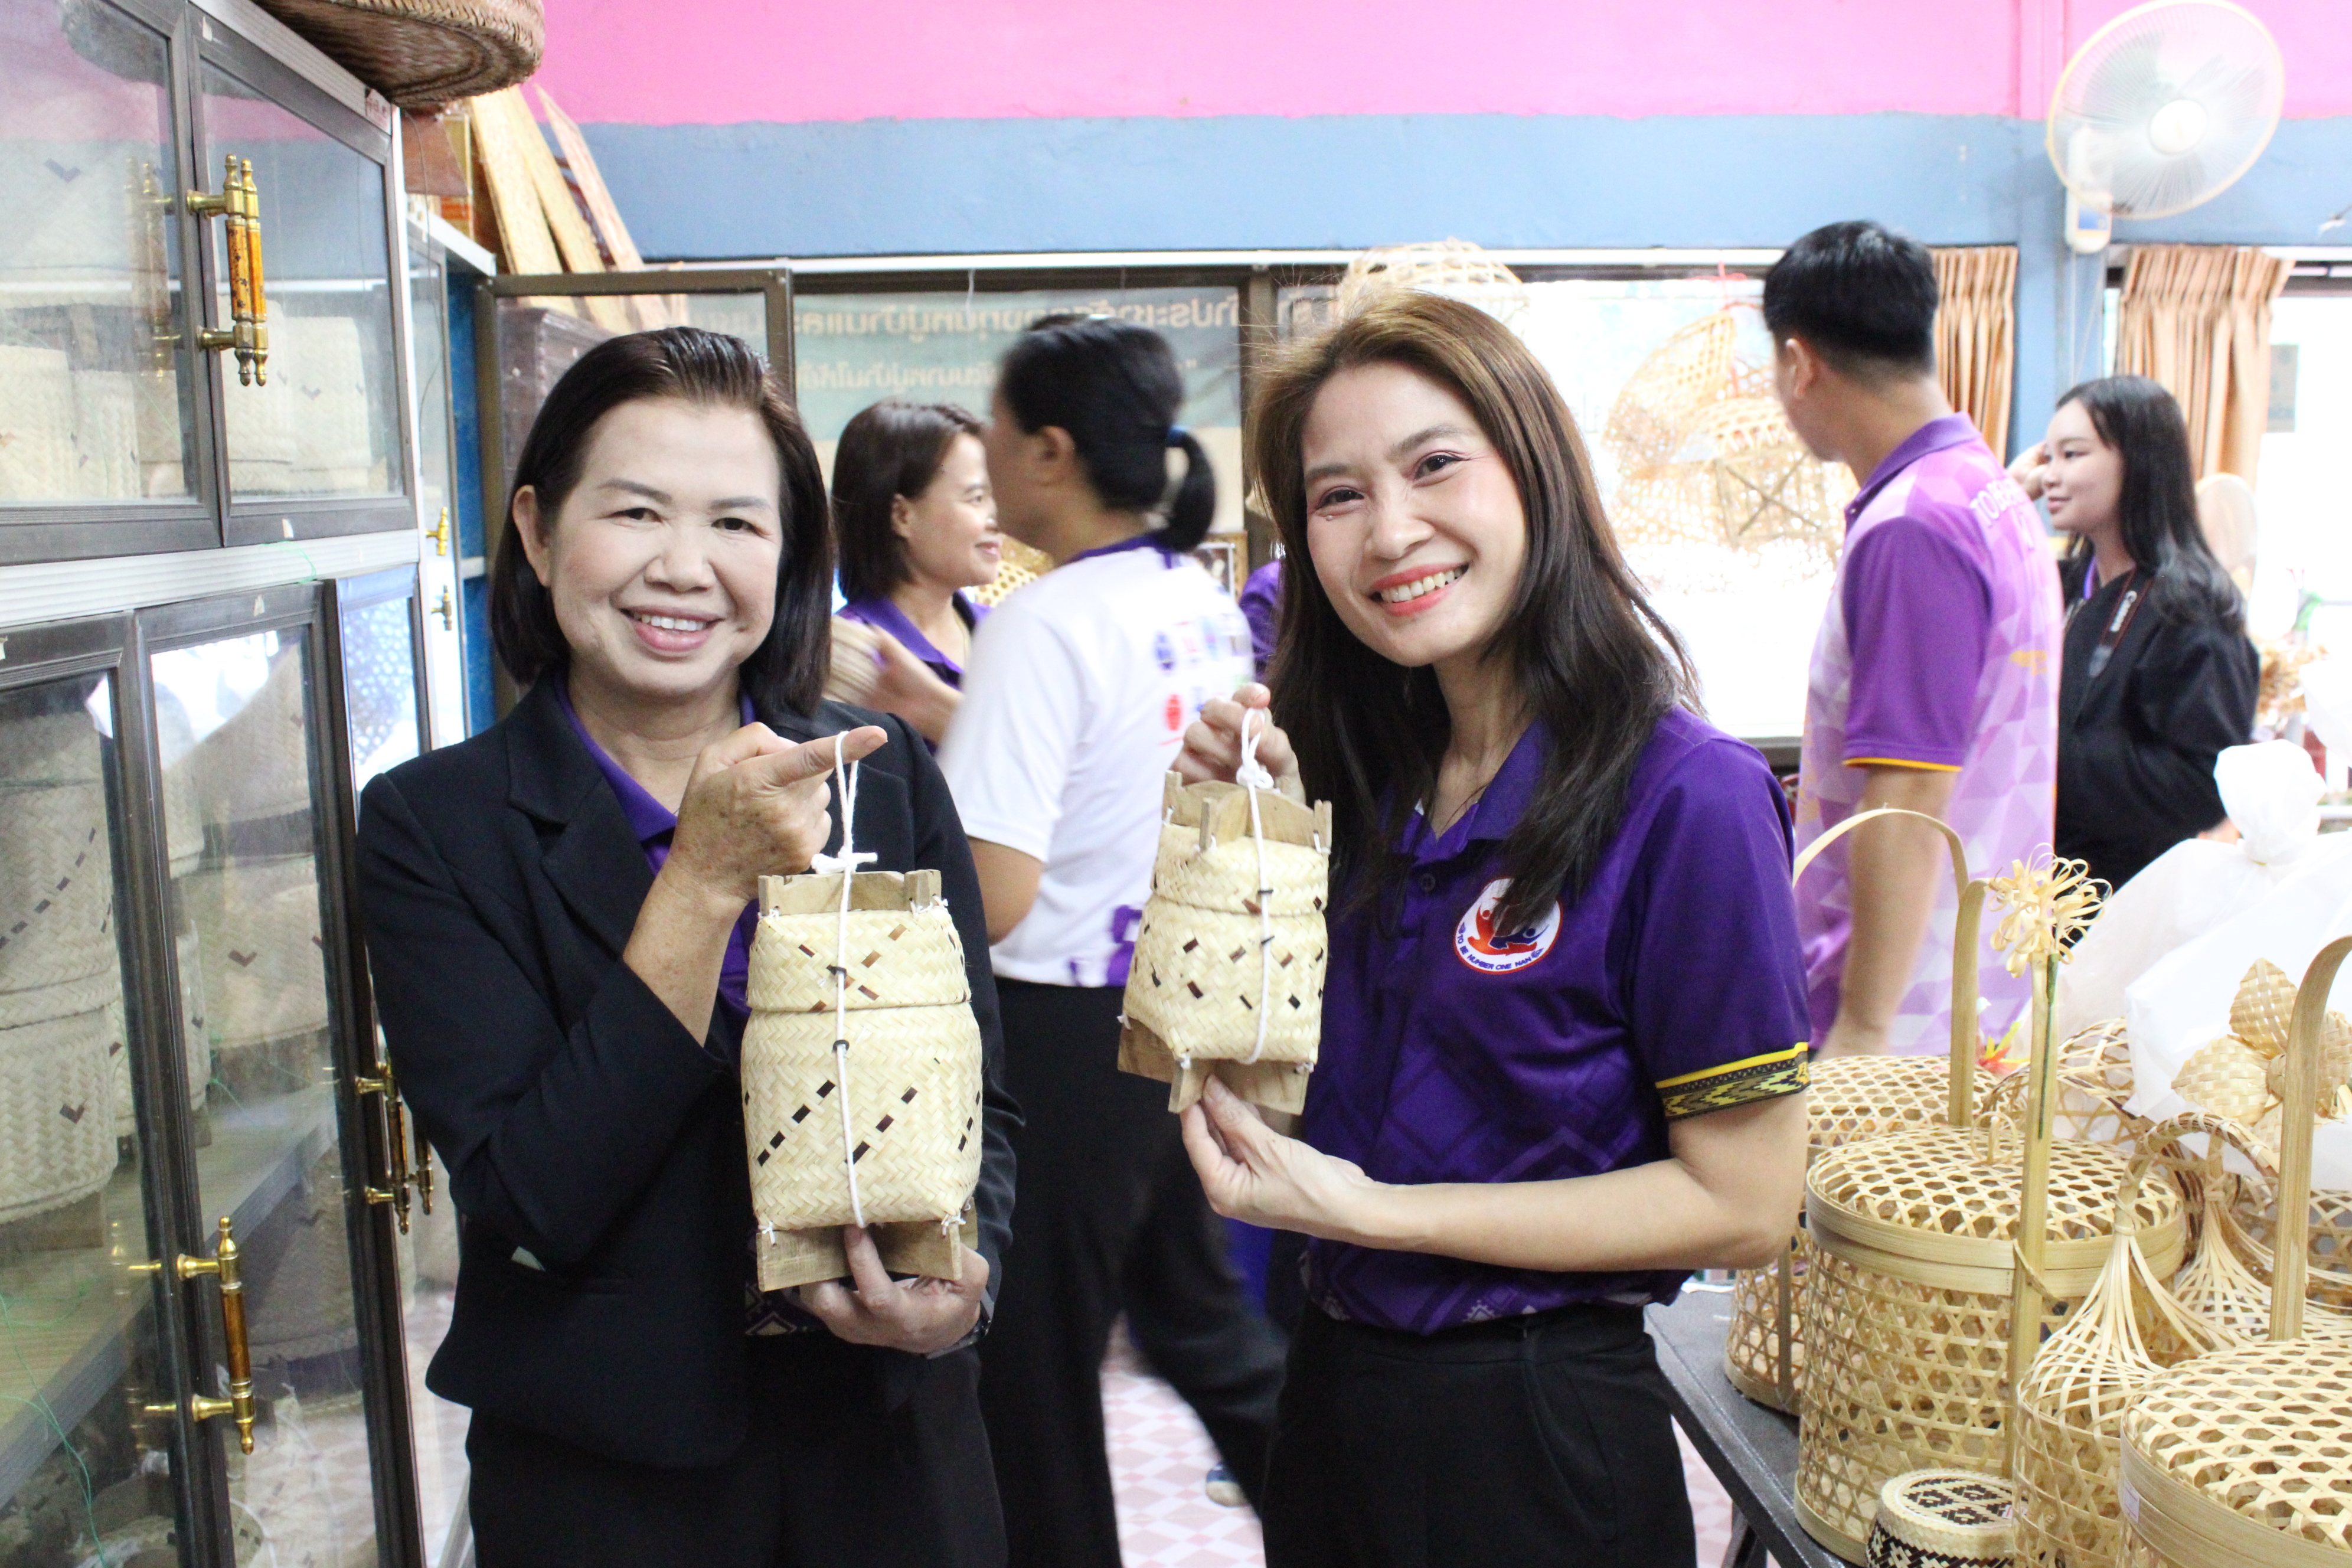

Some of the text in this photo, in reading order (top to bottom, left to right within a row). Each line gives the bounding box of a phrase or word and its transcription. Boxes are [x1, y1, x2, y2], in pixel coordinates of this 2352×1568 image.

[1457, 934, 1464, 944] TO
[1459, 945, 1469, 955] BE
[1466, 953, 1494, 969] NUMBER
[1515, 956, 1531, 967] NAN
